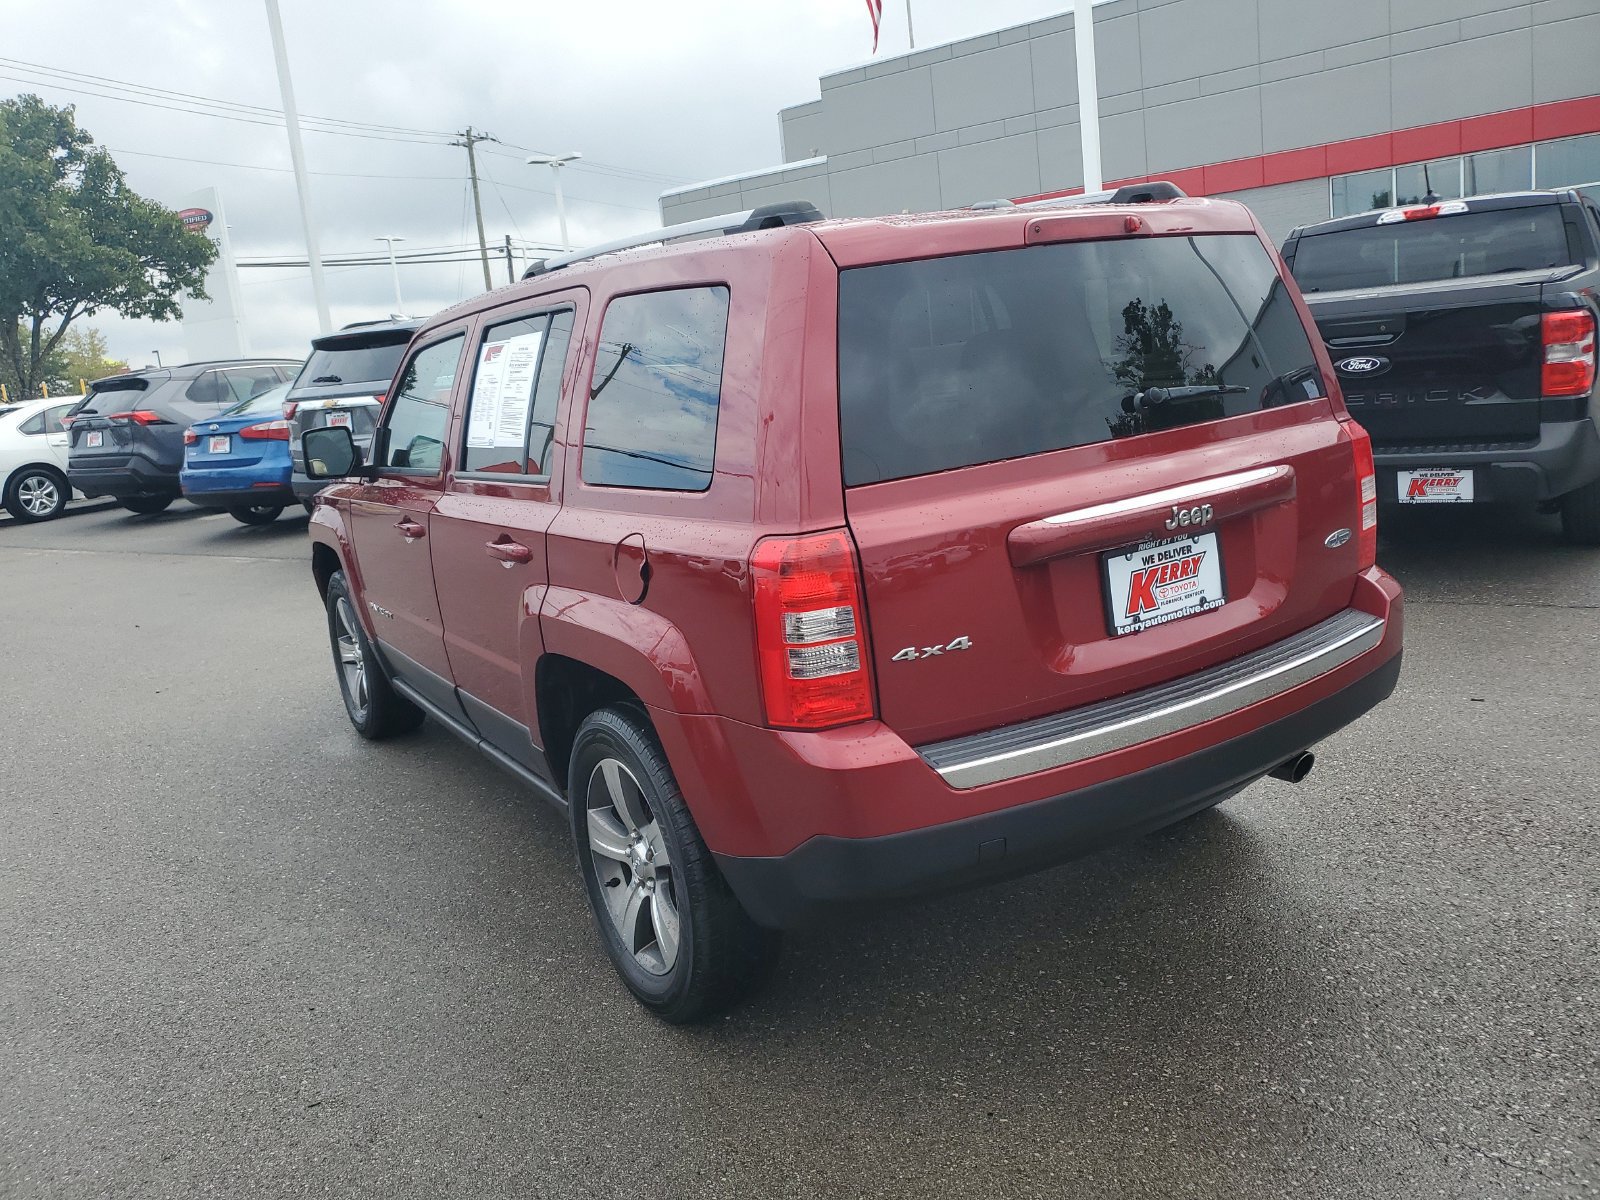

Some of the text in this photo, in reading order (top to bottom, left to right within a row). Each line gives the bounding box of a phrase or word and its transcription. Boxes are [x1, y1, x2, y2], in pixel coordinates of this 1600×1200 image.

[184, 215, 207, 224] TIFIED
[1347, 358, 1372, 370] Ford
[1345, 386, 1482, 405] ERICK
[1406, 477, 1464, 497] KERRY
[1165, 503, 1213, 531] Jeep
[1138, 539, 1161, 552] RIGHT
[1173, 533, 1188, 544] YOU
[1141, 545, 1193, 567] WE DELIVER
[1126, 552, 1205, 618] KERRY
[1169, 580, 1198, 595] TOYOTA
[1117, 598, 1225, 636] kerryautomotive.com
